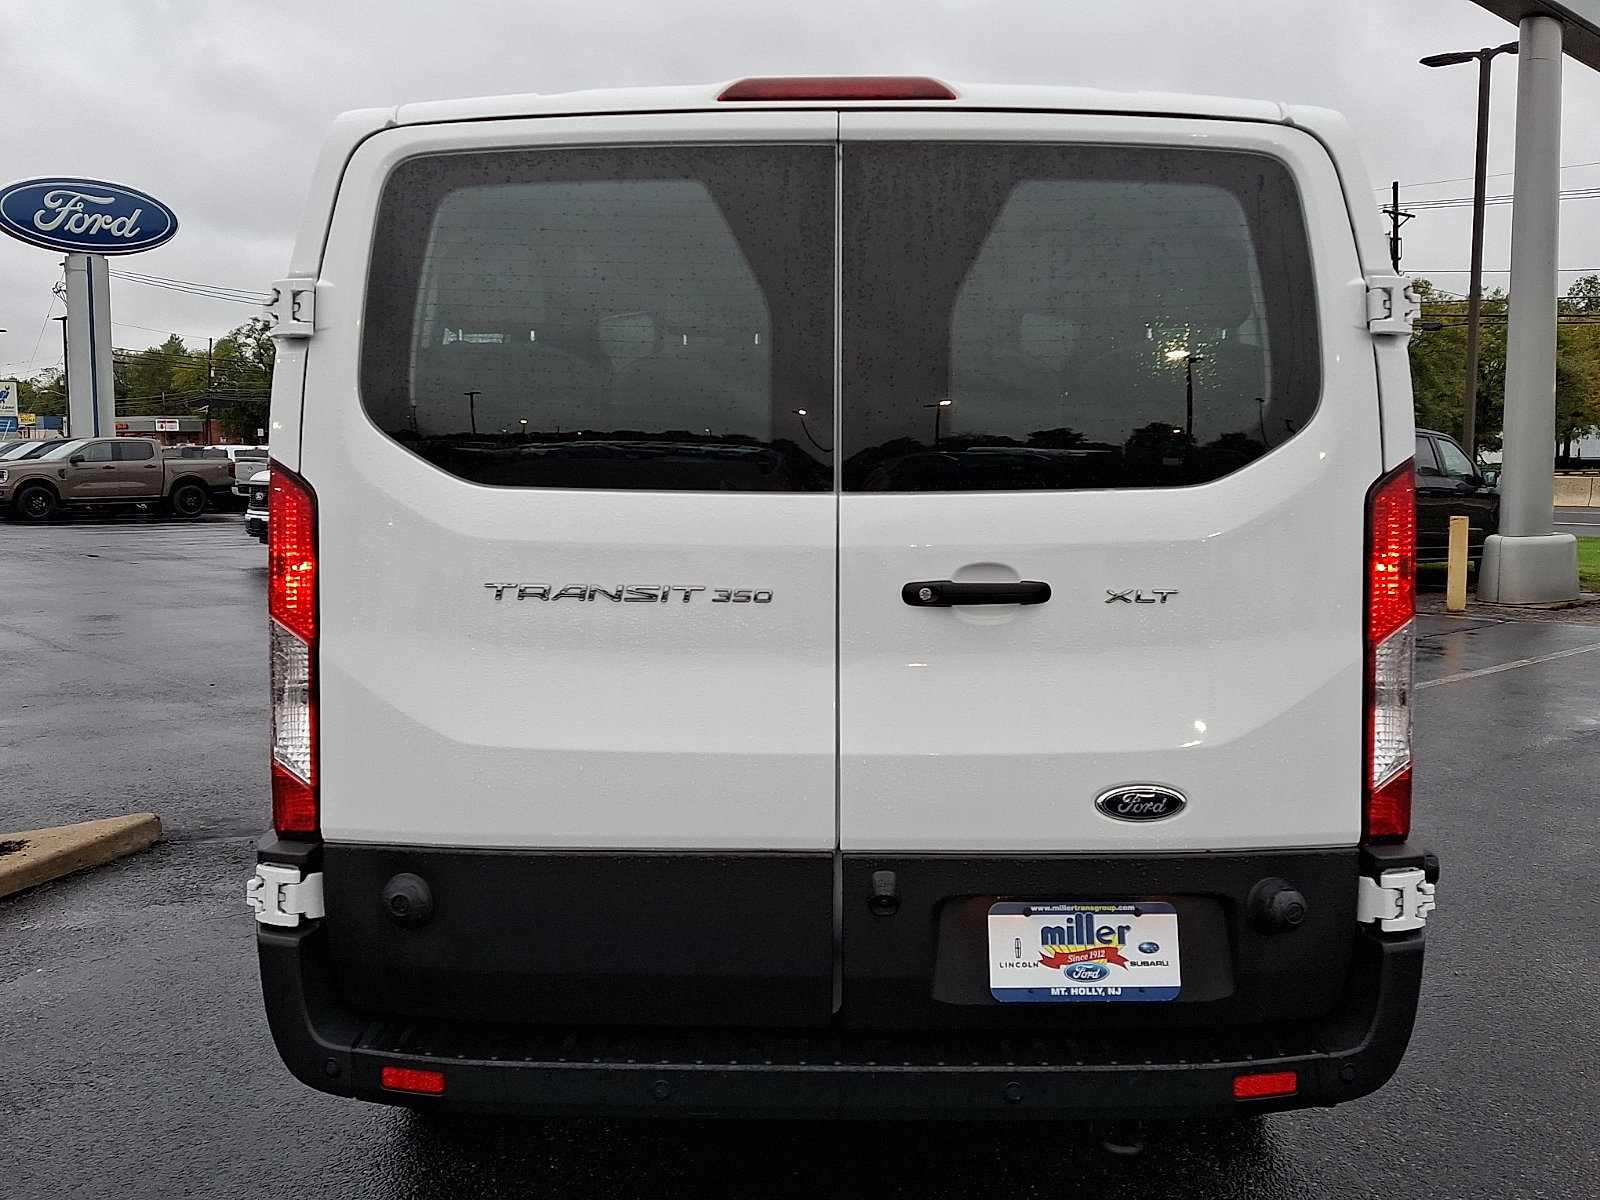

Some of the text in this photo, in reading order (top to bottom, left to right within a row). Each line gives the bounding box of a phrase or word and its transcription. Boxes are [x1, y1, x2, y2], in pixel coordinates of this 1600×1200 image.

[34, 190, 143, 238] Ford
[484, 582, 774, 604] TRANSIT 350
[1104, 588, 1179, 603] XLT
[1118, 793, 1167, 813] Ford
[1030, 904, 1135, 912] www.millertransgroup.com
[1041, 913, 1131, 945] miller
[1067, 949, 1106, 963] Since 1912
[1072, 965, 1101, 979] Ford
[1051, 987, 1122, 996] MT. HOLLY, NJ
